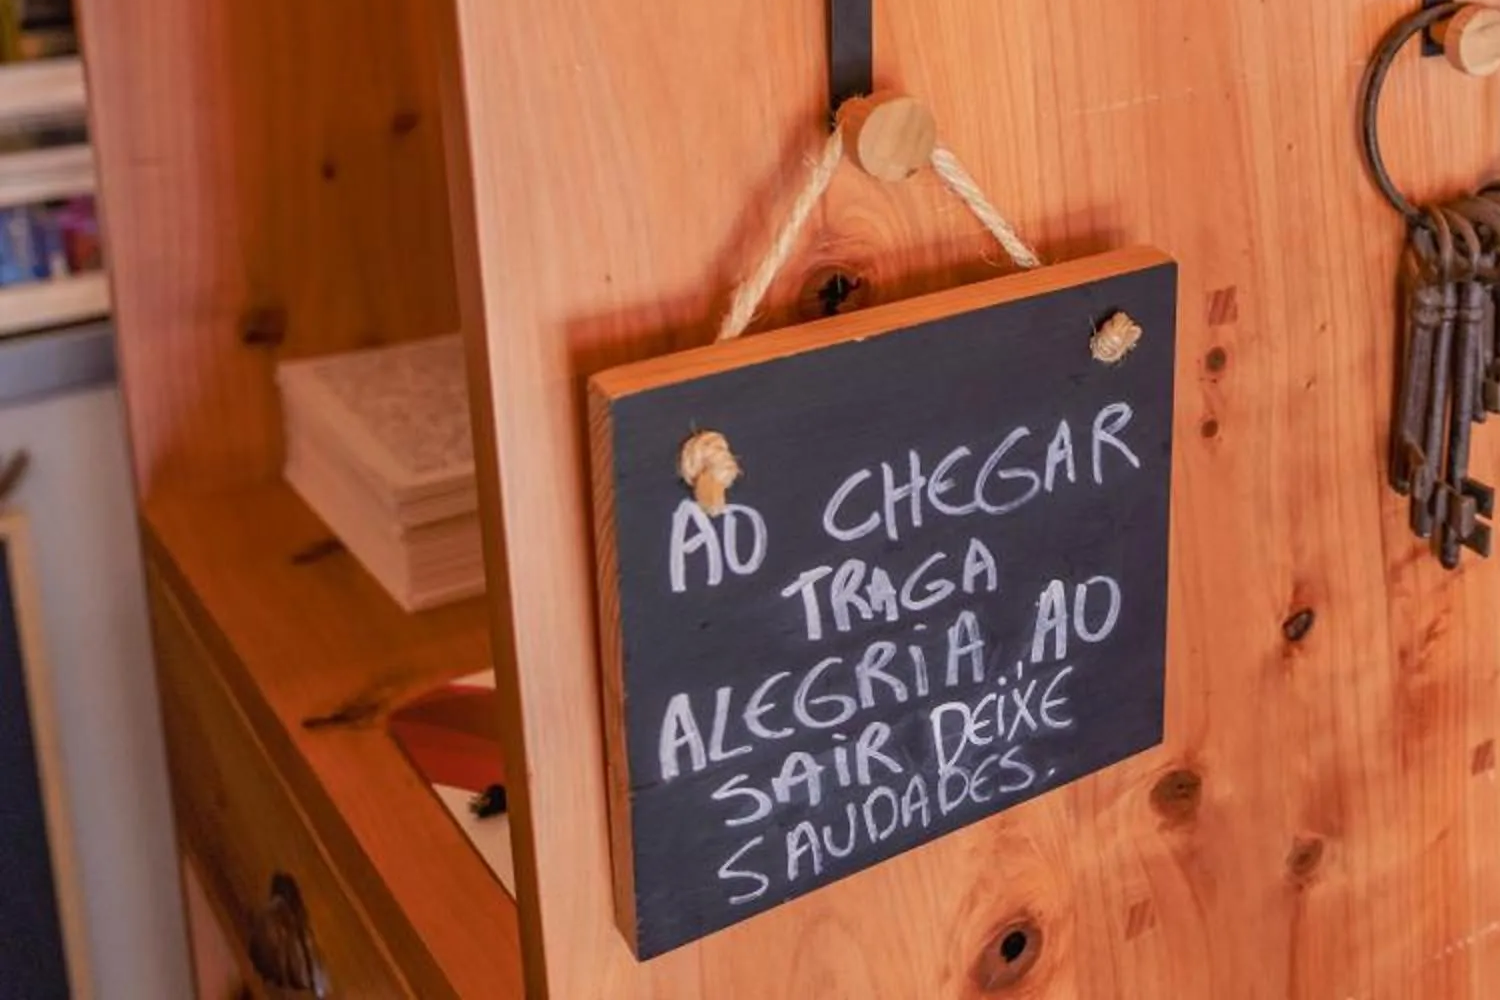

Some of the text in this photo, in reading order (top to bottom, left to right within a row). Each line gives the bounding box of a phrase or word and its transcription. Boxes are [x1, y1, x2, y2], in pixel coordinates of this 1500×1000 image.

[669, 402, 1140, 592] AO CHEGAR
[781, 537, 997, 640] TRAGA
[1031, 575, 1122, 663] AO
[711, 665, 1074, 826] SAIR DEIXE
